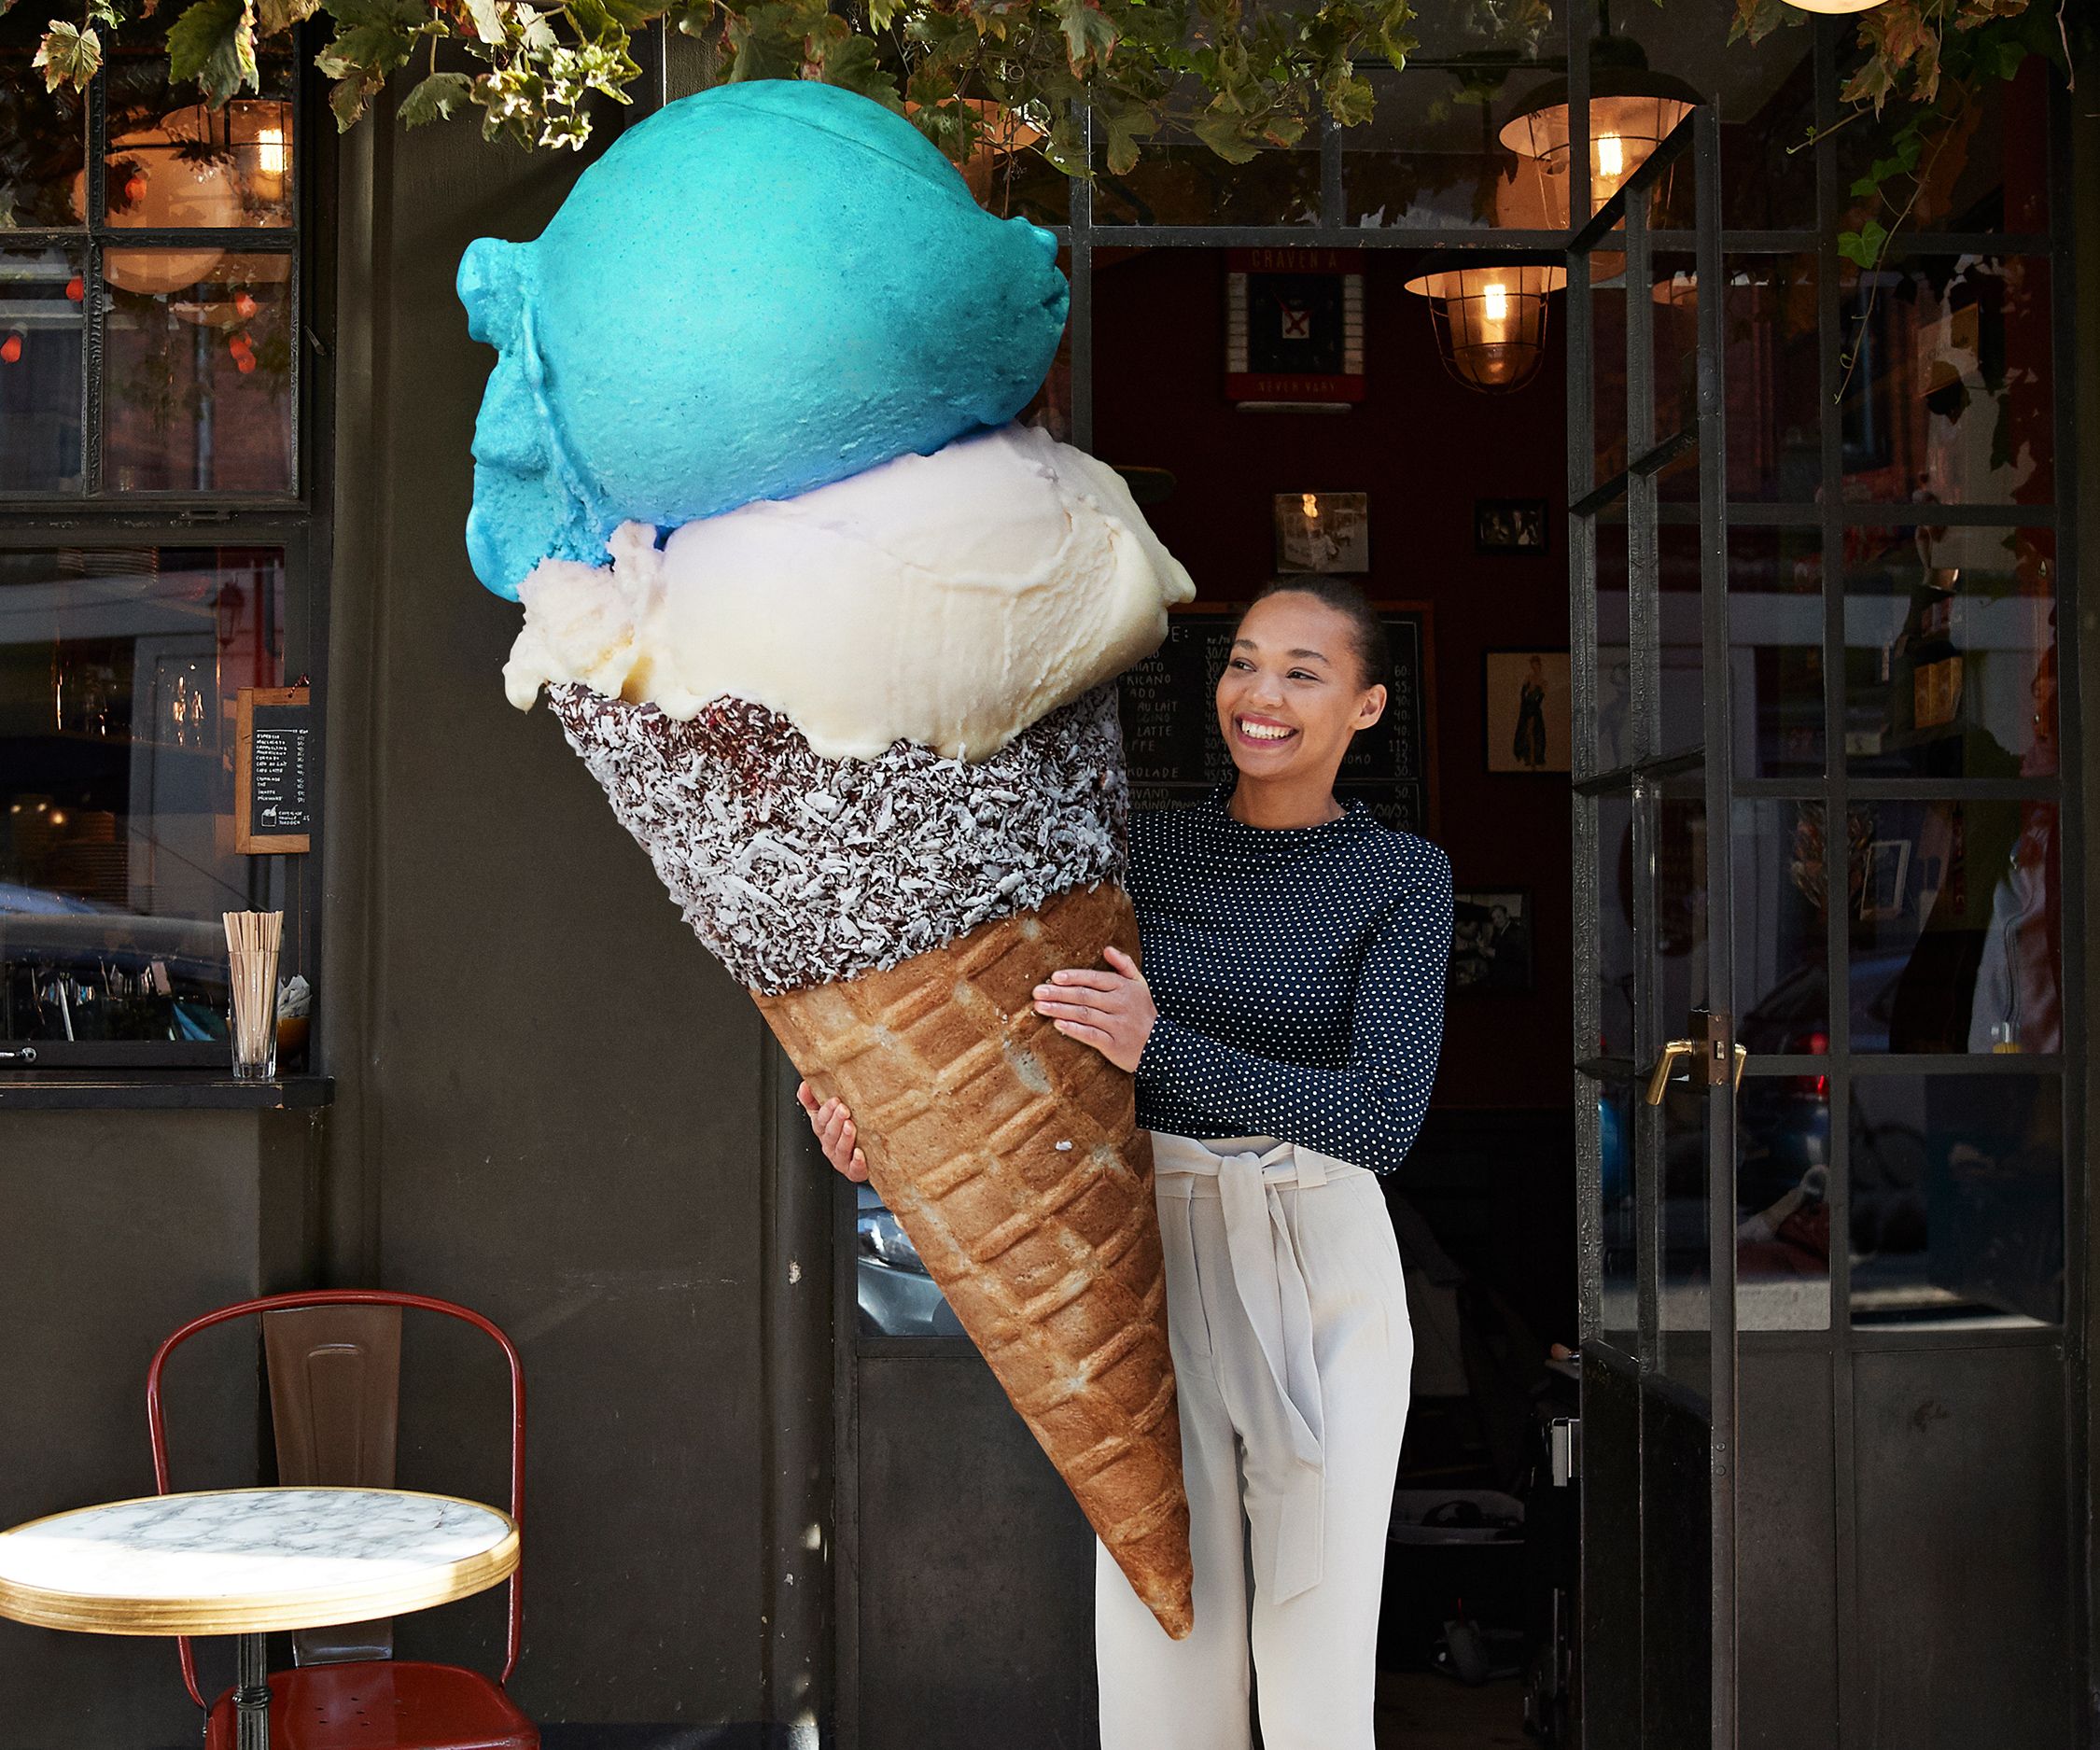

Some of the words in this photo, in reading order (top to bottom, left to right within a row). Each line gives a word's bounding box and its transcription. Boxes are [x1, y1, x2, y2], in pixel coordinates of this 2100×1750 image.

[1252, 249, 1320, 269] CRAVEN
[1327, 249, 1338, 269] A
[1256, 381, 1300, 392] NEVER
[1137, 724, 1173, 737] LATTE
